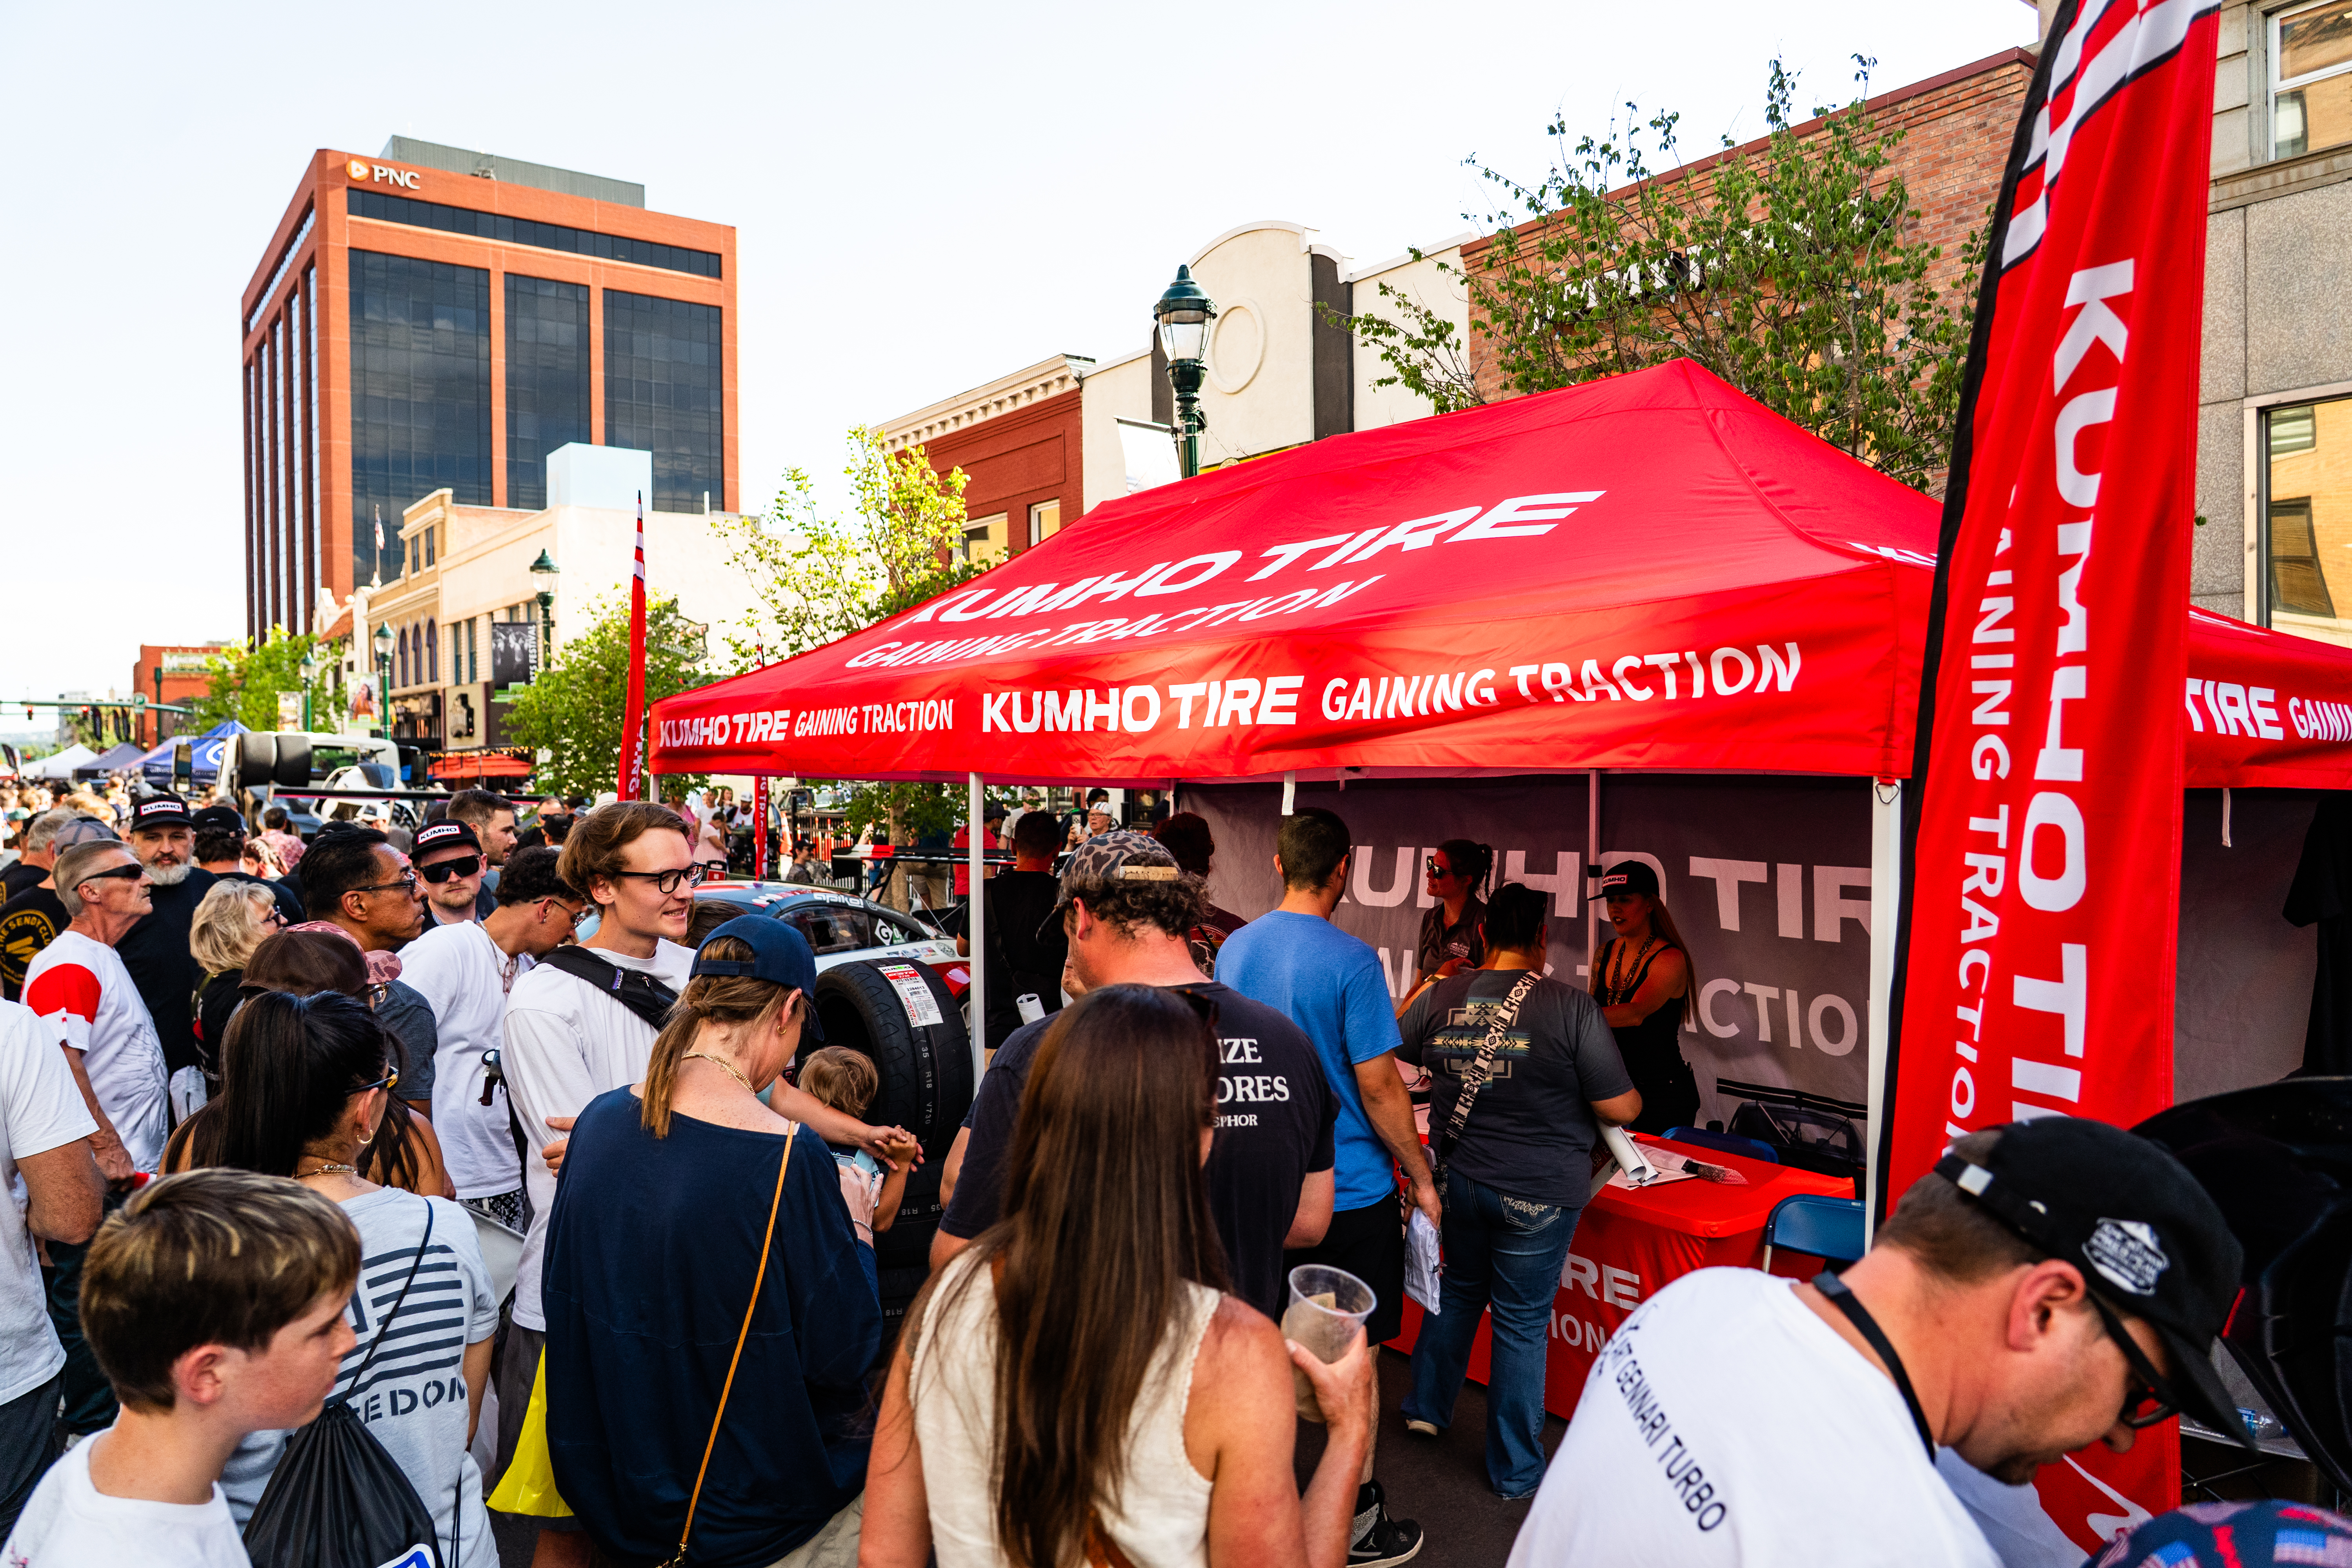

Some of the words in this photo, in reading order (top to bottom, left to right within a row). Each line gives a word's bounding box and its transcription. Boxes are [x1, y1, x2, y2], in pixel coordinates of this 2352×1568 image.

[371, 164, 420, 189] PNC
[890, 550, 1242, 631] KUMHO
[1244, 491, 1606, 582] TIRE
[845, 628, 1050, 668] GAINING
[1031, 575, 1385, 648] TRACTION
[982, 684, 1160, 733] KUMHO
[1169, 675, 1304, 729] TIRE
[1321, 669, 1497, 722] GAINING
[1509, 642, 1801, 704] TRACTION
[659, 714, 731, 748] KUMHO
[733, 709, 790, 743] TIRE
[795, 706, 858, 737] GAINING
[862, 699, 954, 735] TRACTION
[420, 828, 457, 840] KUMHO
[813, 893, 864, 908] apikol
[879, 925, 890, 940] G
[353, 1377, 468, 1424] EDOM
[1616, 1359, 1672, 1448] GENNARI
[1657, 1435, 1726, 1532] TURBO
